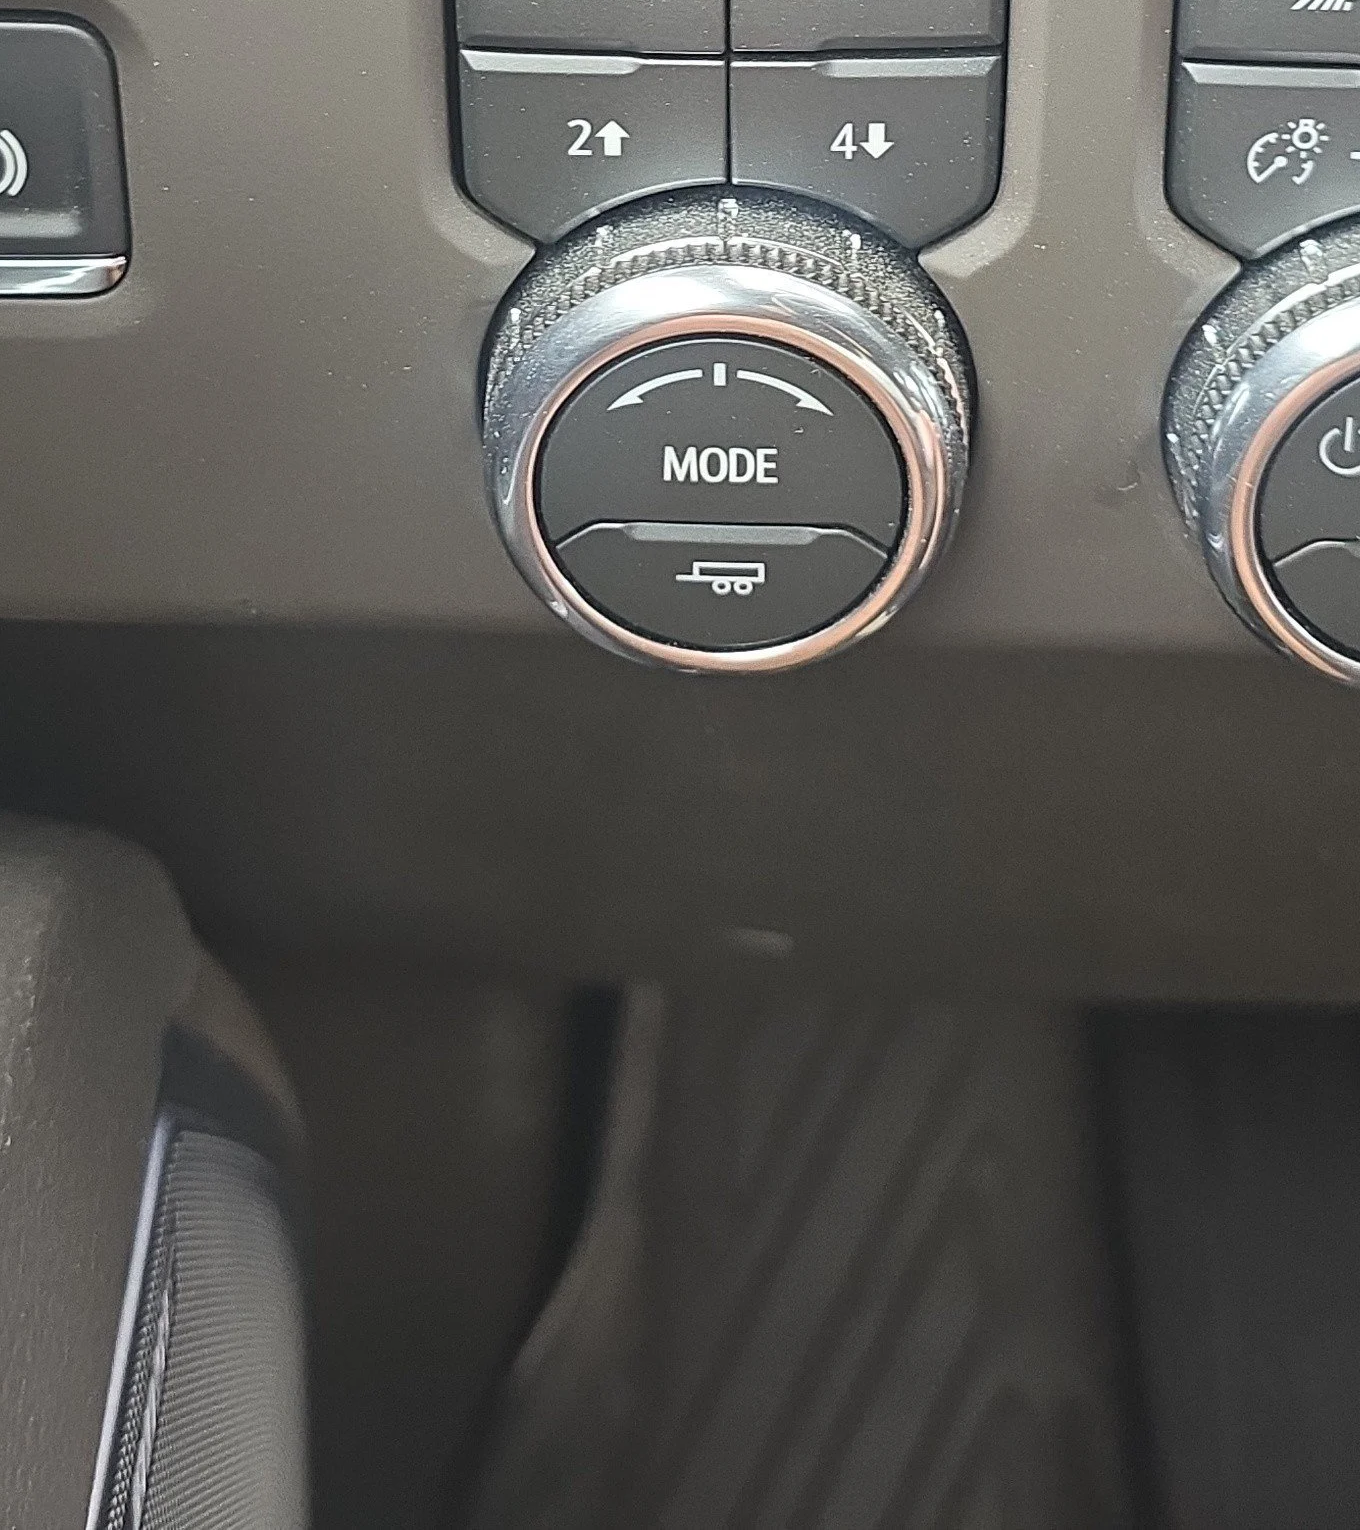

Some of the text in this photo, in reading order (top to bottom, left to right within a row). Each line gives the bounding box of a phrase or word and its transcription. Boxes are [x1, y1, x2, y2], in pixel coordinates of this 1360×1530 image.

[567, 119, 594, 157] 2
[830, 122, 859, 161] 4
[663, 445, 779, 484] MODE
